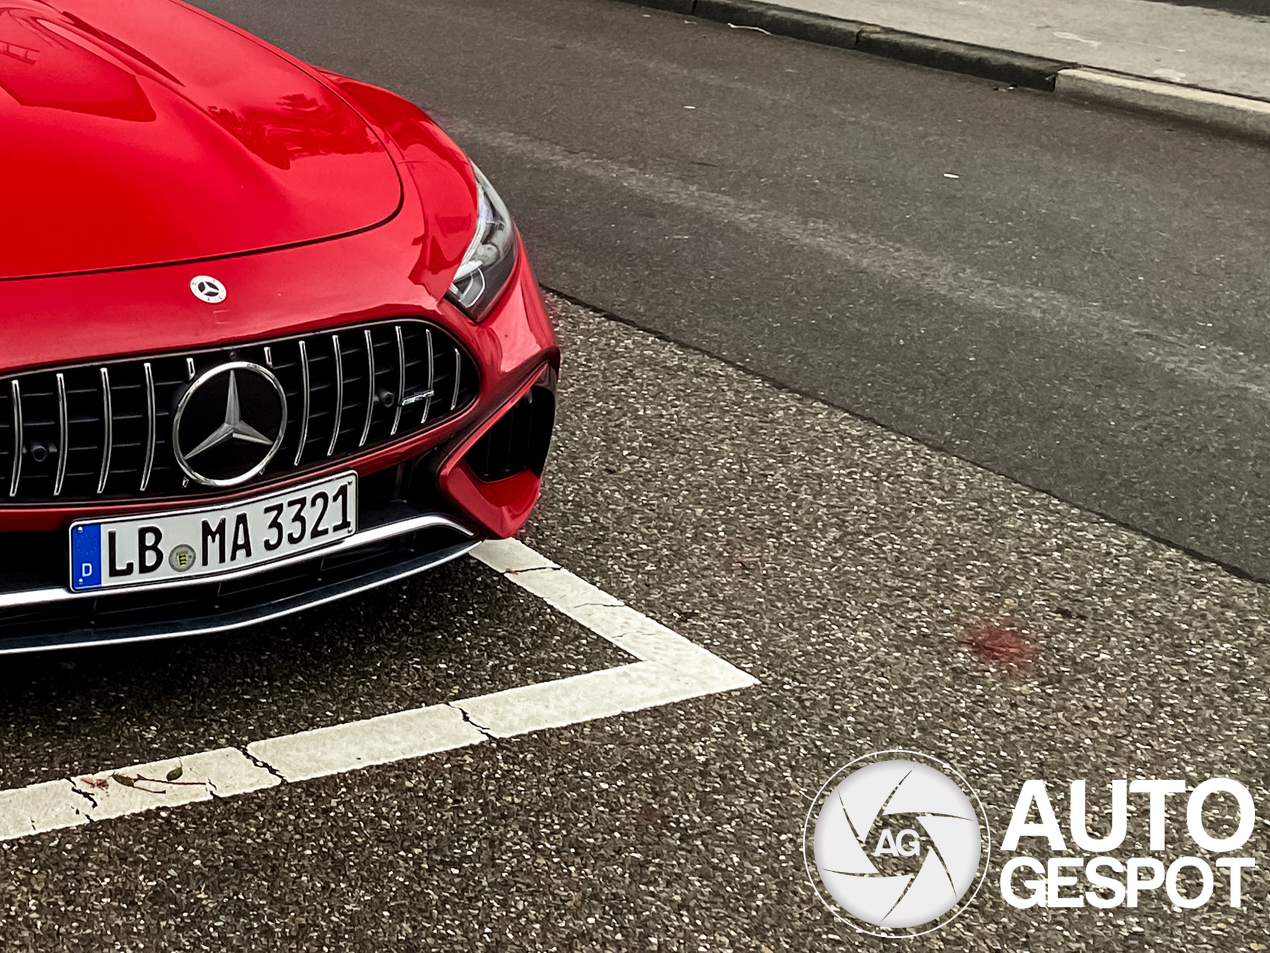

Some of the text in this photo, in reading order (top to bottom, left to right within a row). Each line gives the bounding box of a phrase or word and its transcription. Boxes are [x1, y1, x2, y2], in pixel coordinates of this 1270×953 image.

[108, 483, 352, 578] LB MA 3321
[82, 563, 92, 577] D
